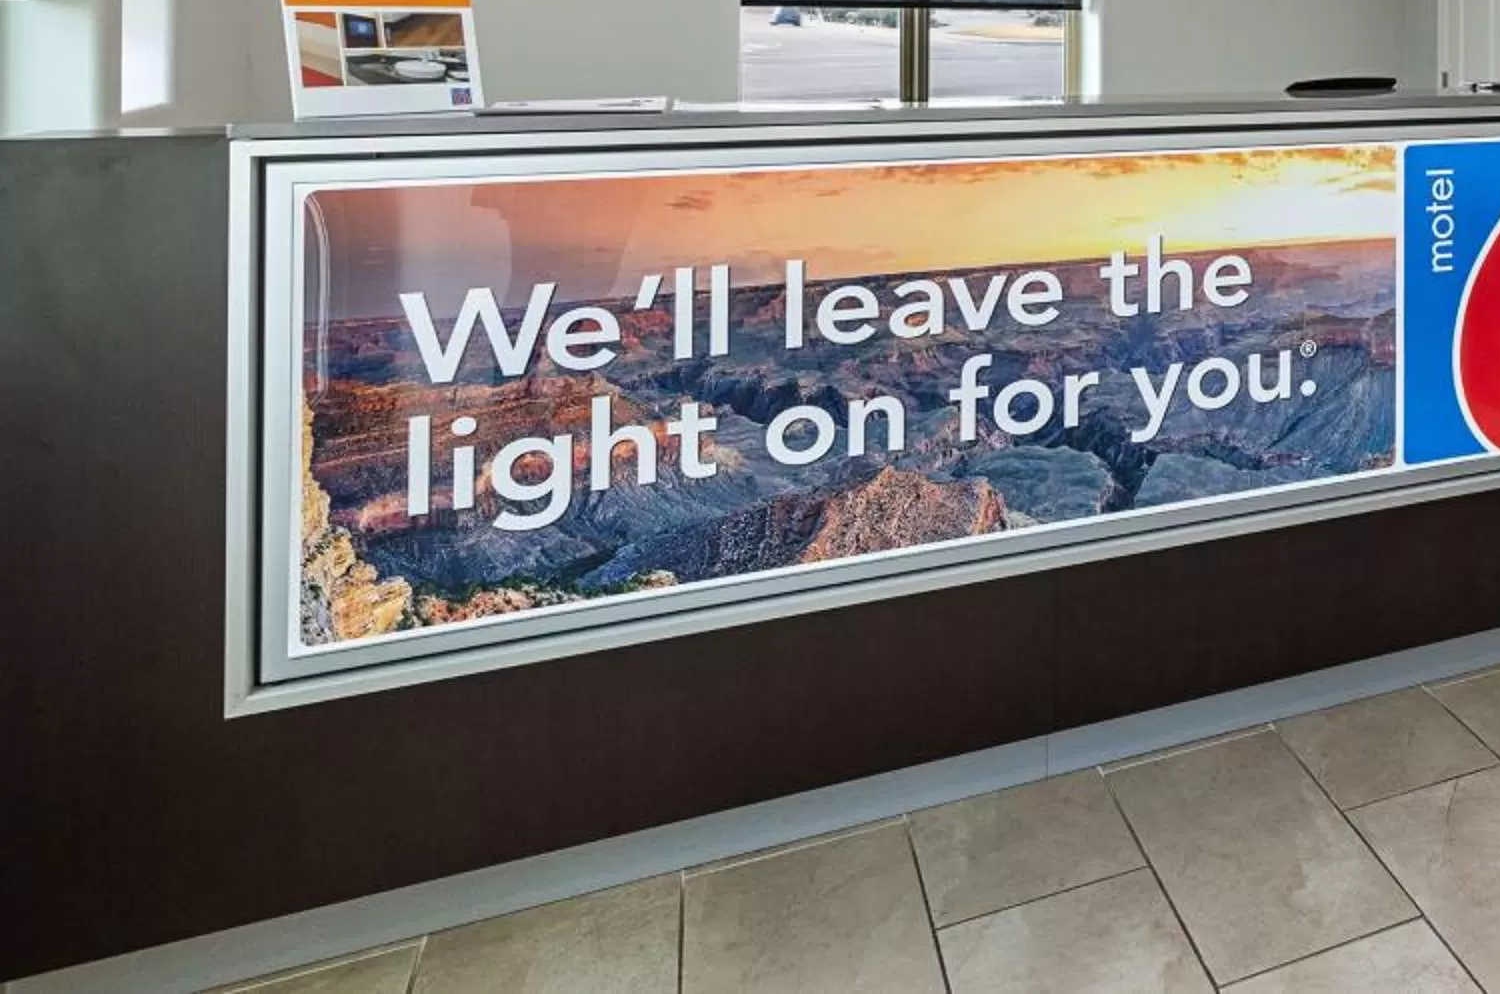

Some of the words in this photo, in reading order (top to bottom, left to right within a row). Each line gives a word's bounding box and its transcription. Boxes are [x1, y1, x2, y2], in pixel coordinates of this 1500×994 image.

[1425, 169, 1454, 272] motel
[399, 263, 731, 385] We'll
[785, 259, 1061, 350] leave
[1100, 234, 1253, 318] the
[406, 396, 717, 531] light
[765, 395, 905, 465] on
[949, 354, 1099, 443] for
